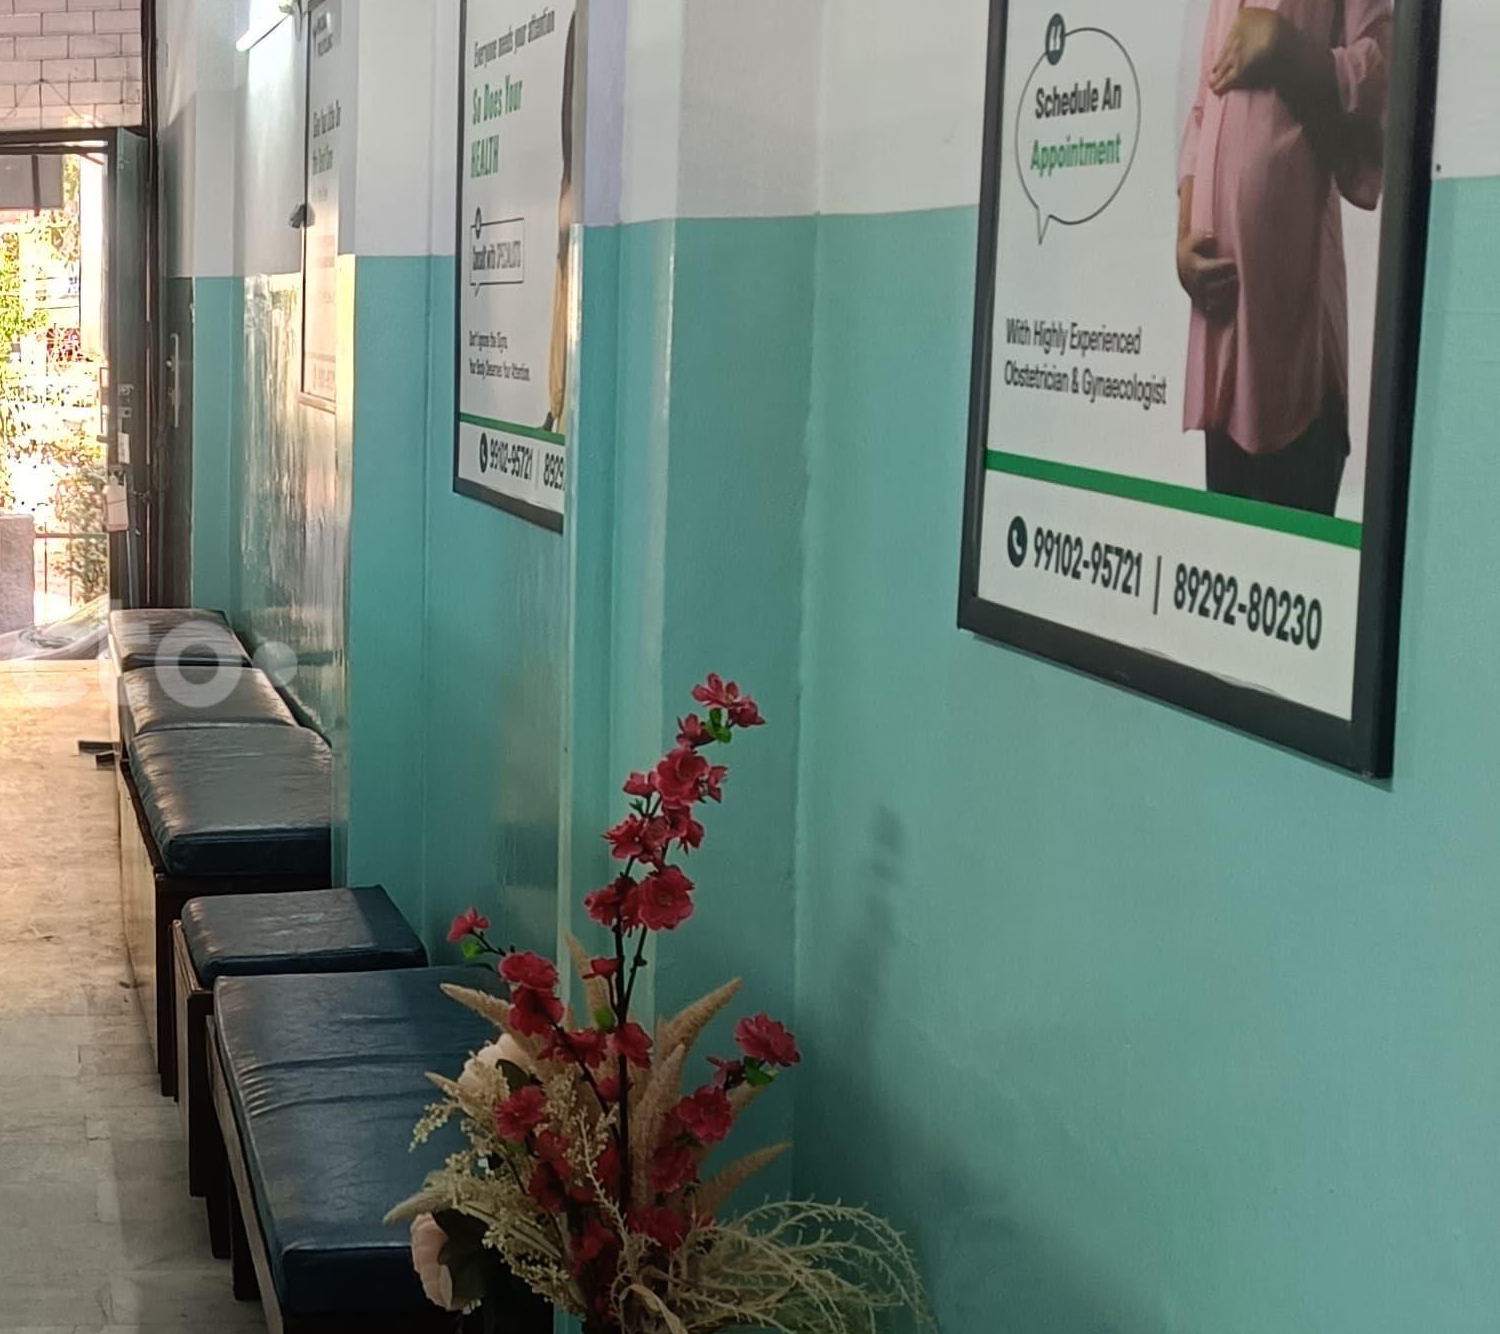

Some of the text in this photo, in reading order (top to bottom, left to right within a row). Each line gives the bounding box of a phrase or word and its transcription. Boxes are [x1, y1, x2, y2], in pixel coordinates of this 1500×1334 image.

[1034, 80, 1122, 120] Schedule An
[1029, 132, 1121, 173] Appointment
[1005, 316, 1141, 357] With Highly Experienced
[1003, 363, 1167, 410] Obstetrician & Gynaecologist
[1032, 527, 1322, 651] 99102-95721 89292-80230
